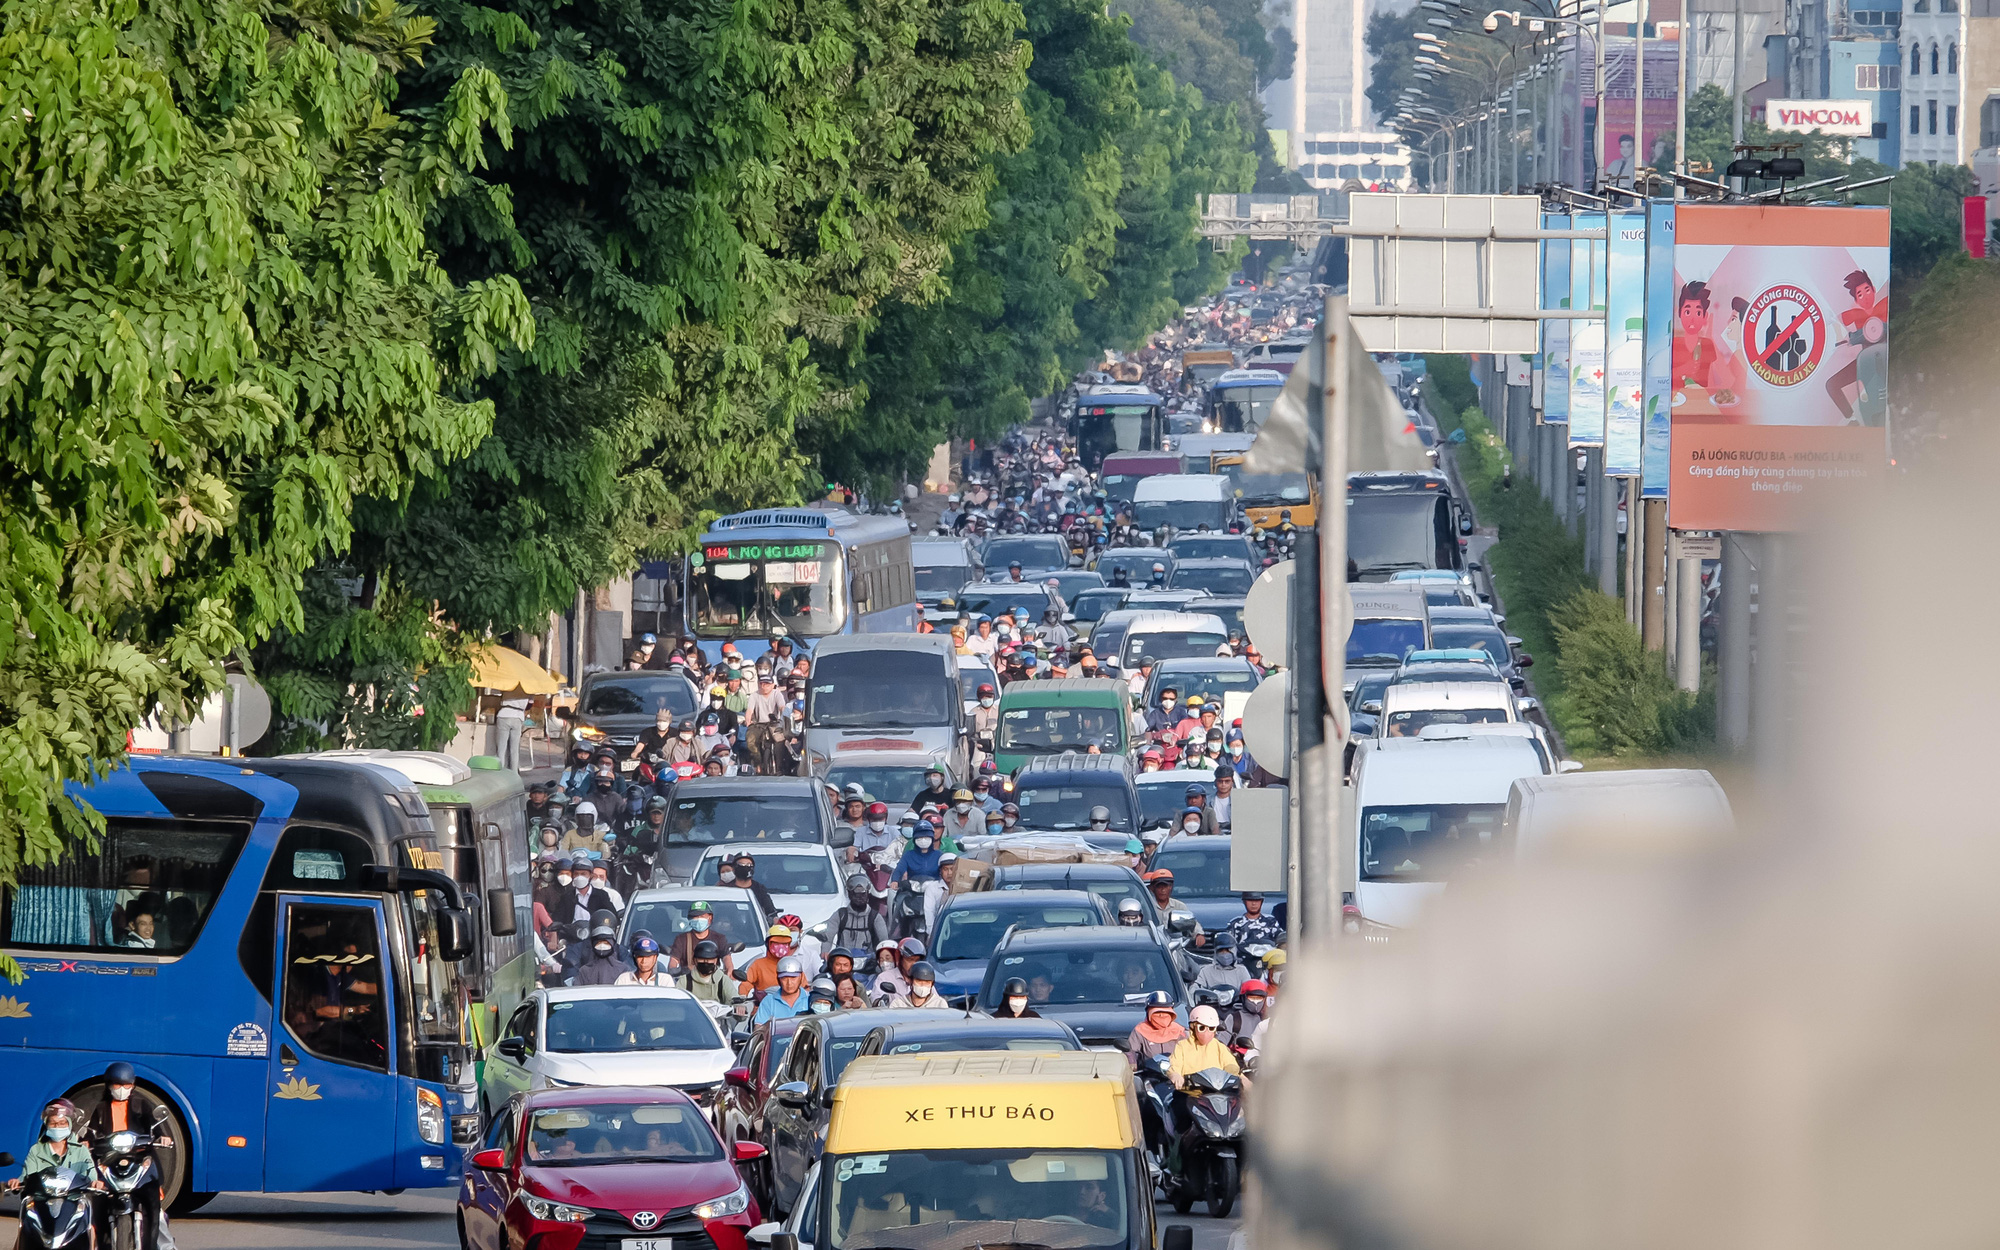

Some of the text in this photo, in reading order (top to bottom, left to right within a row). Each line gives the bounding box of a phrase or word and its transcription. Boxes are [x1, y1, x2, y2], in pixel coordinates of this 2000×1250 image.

[1613, 87, 1673, 99] CHRME
[1778, 108, 1861, 125] VINCOM
[1757, 289, 1782, 308] UỐNG
[1808, 304, 1820, 323] BIA
[1751, 360, 1816, 385] KHÔNG LÁI XE
[1708, 448, 1737, 461] UỐNG
[1770, 453, 1785, 461] BIA
[1689, 465, 1713, 478] Cộng
[1786, 467, 1815, 479] chung
[1752, 481, 1780, 493] thông
[706, 546, 729, 558] 104
[797, 564, 816, 580] 104
[1354, 602, 1399, 610] OUNGE
[905, 1103, 1054, 1123] XE THƯ BÁO
[636, 1241, 657, 1250] 51K
